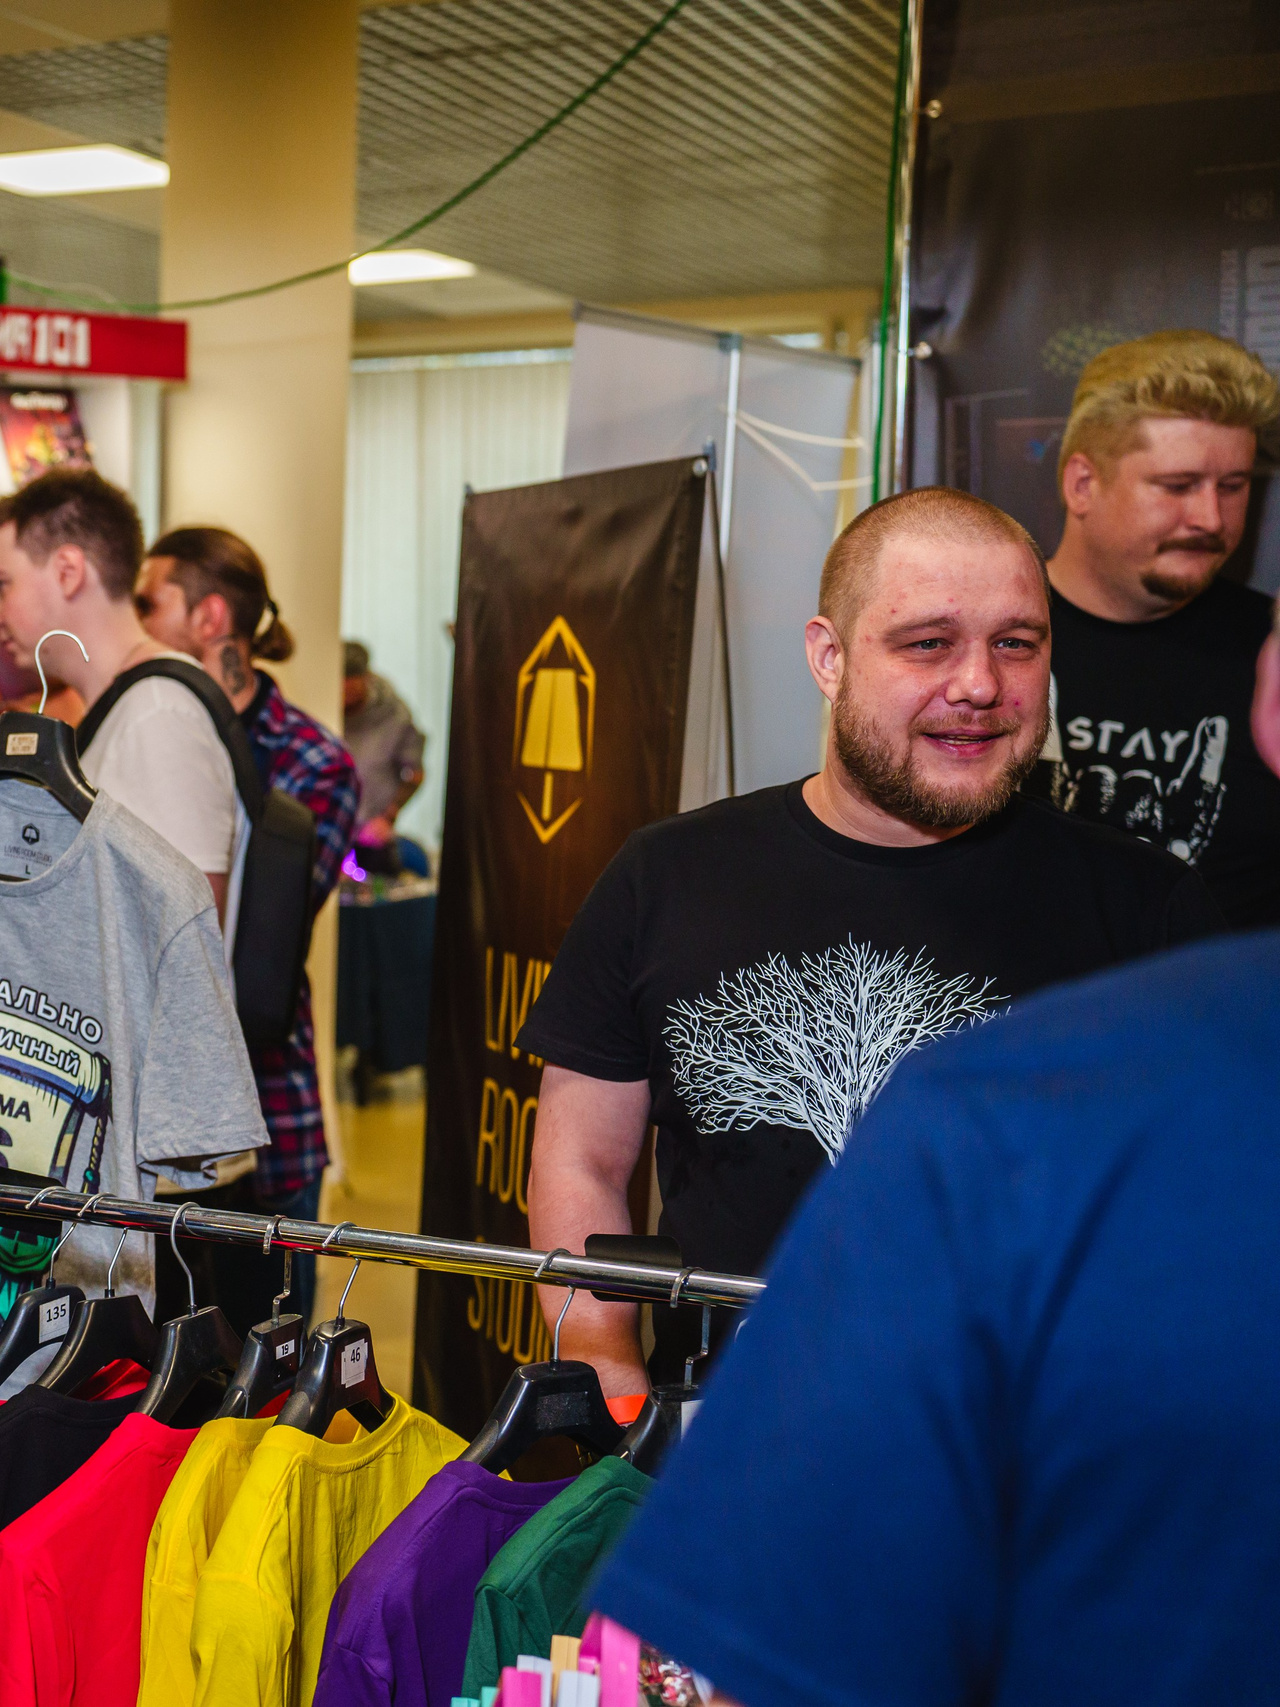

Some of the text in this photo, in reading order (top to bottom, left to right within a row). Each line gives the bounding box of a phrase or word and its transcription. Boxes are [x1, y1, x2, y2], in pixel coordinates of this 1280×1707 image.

[33, 315, 91, 368] 101
[1066, 715, 1190, 763] STAY
[25, 864, 31, 875] L
[46, 1303, 67, 1323] 135
[281, 1344, 289, 1356] 19
[350, 1347, 361, 1364] 46
